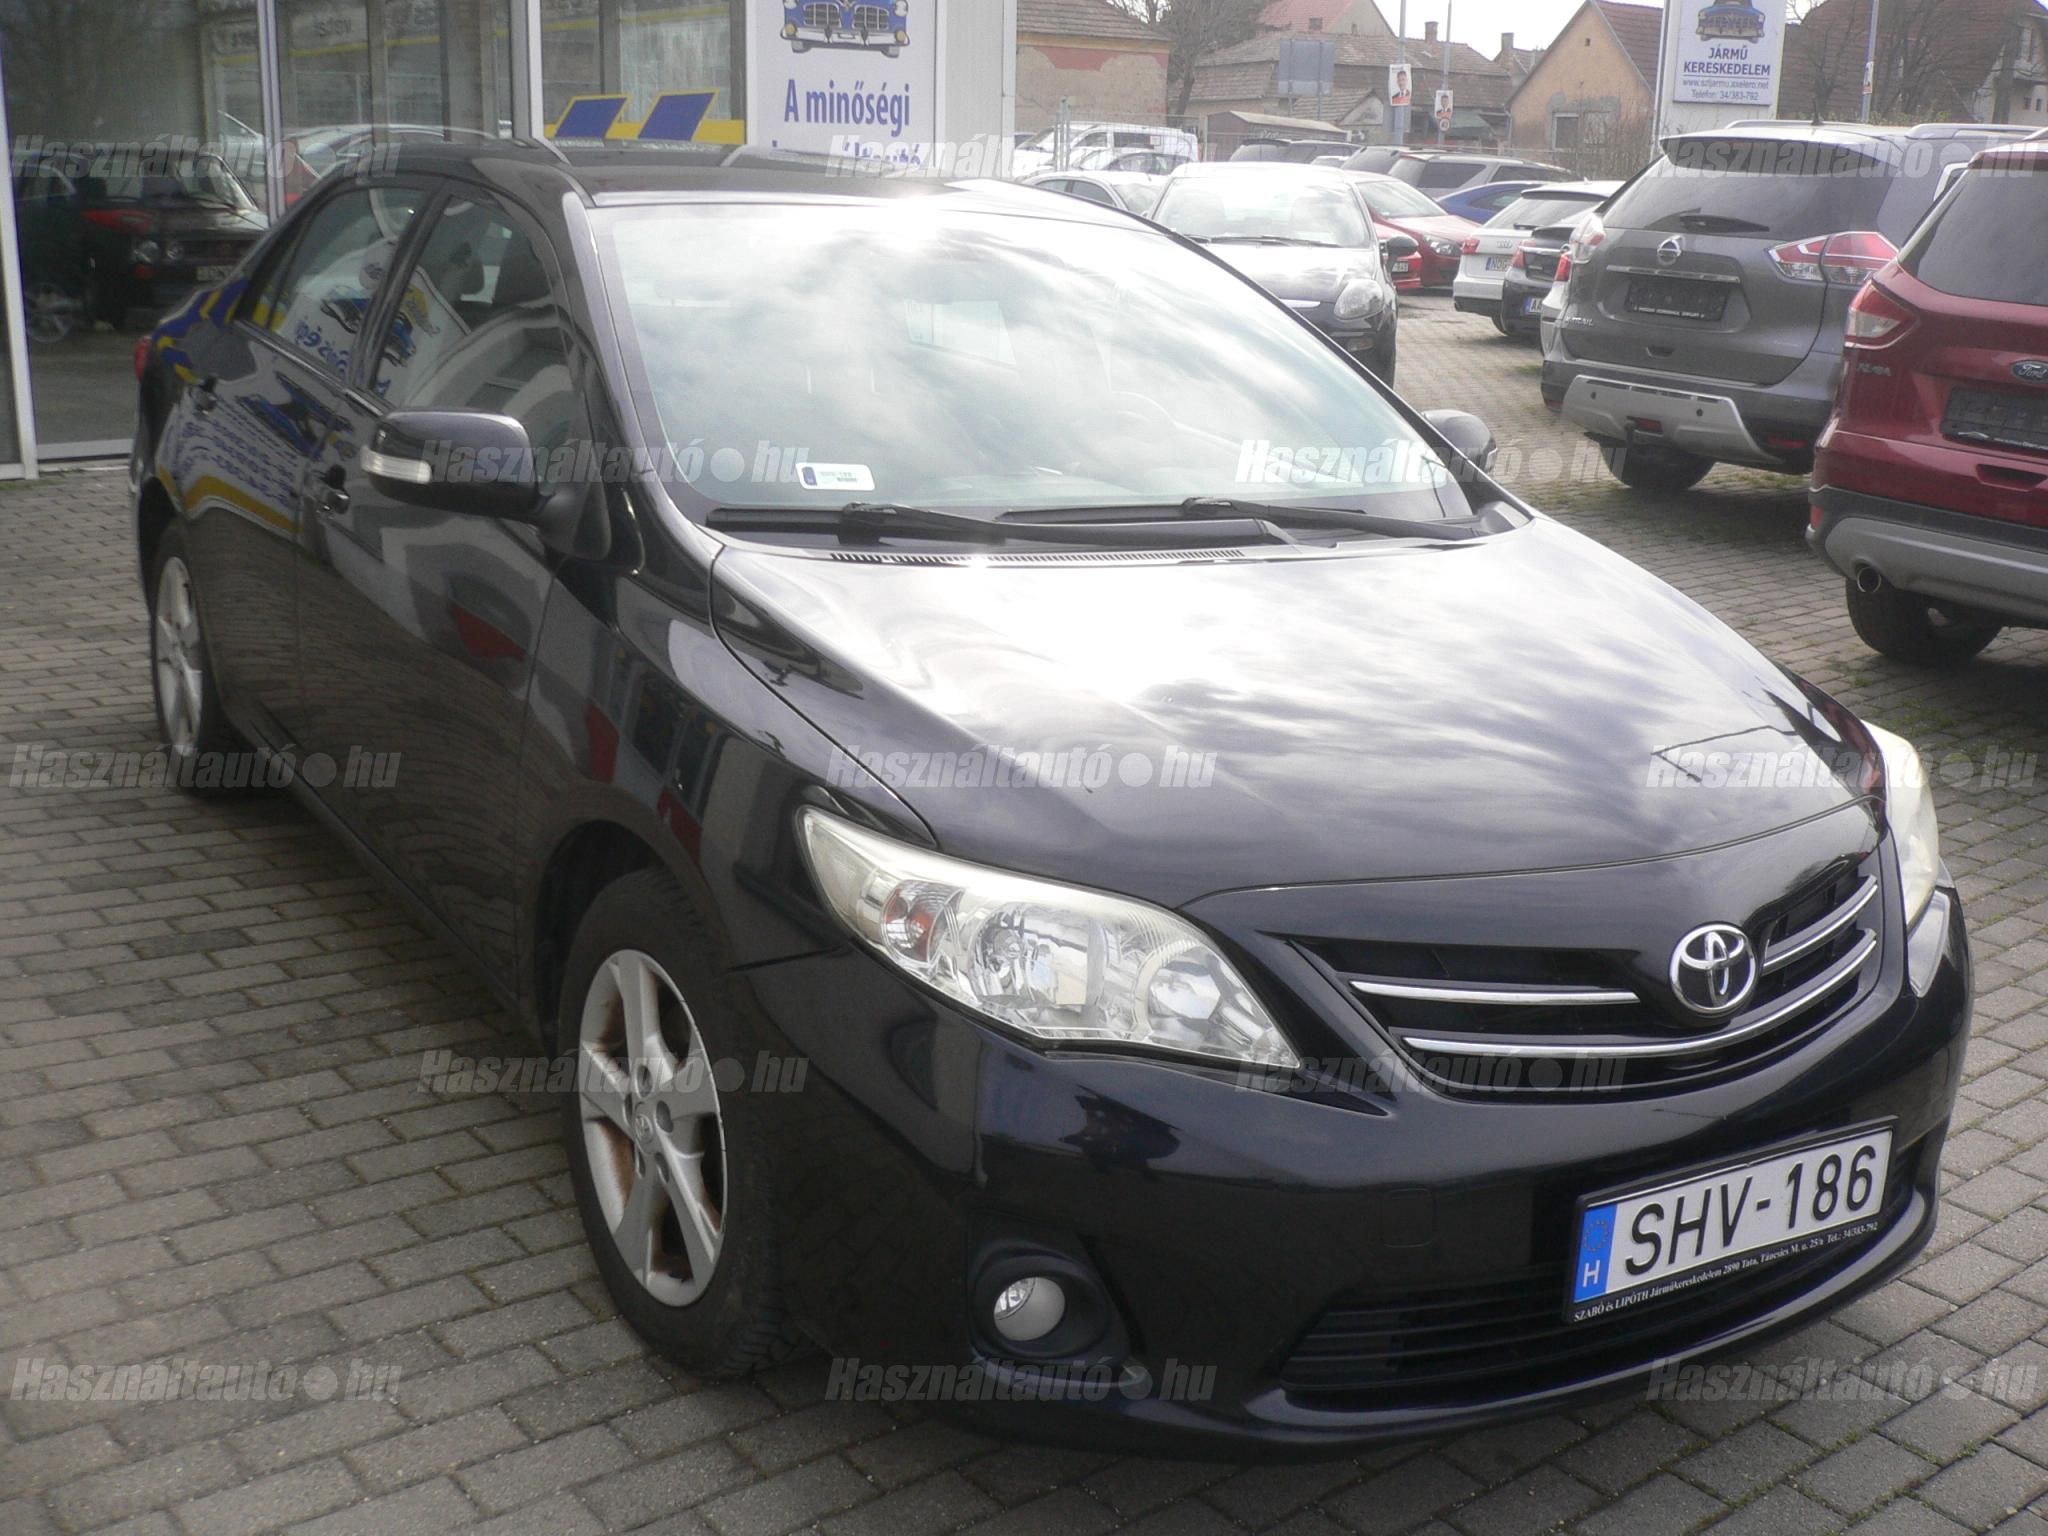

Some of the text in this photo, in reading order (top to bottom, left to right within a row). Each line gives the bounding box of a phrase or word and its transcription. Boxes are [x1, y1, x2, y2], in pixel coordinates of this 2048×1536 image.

[1683, 61, 1770, 76] KERESKEDELEM
[784, 78, 911, 138] A minőségi
[1625, 1144, 1877, 1276] SHV-186
[1582, 1260, 1600, 1288] H
[1574, 1301, 1605, 1322] SZABÓ
[1615, 1290, 1649, 1309] LIPÓTH
